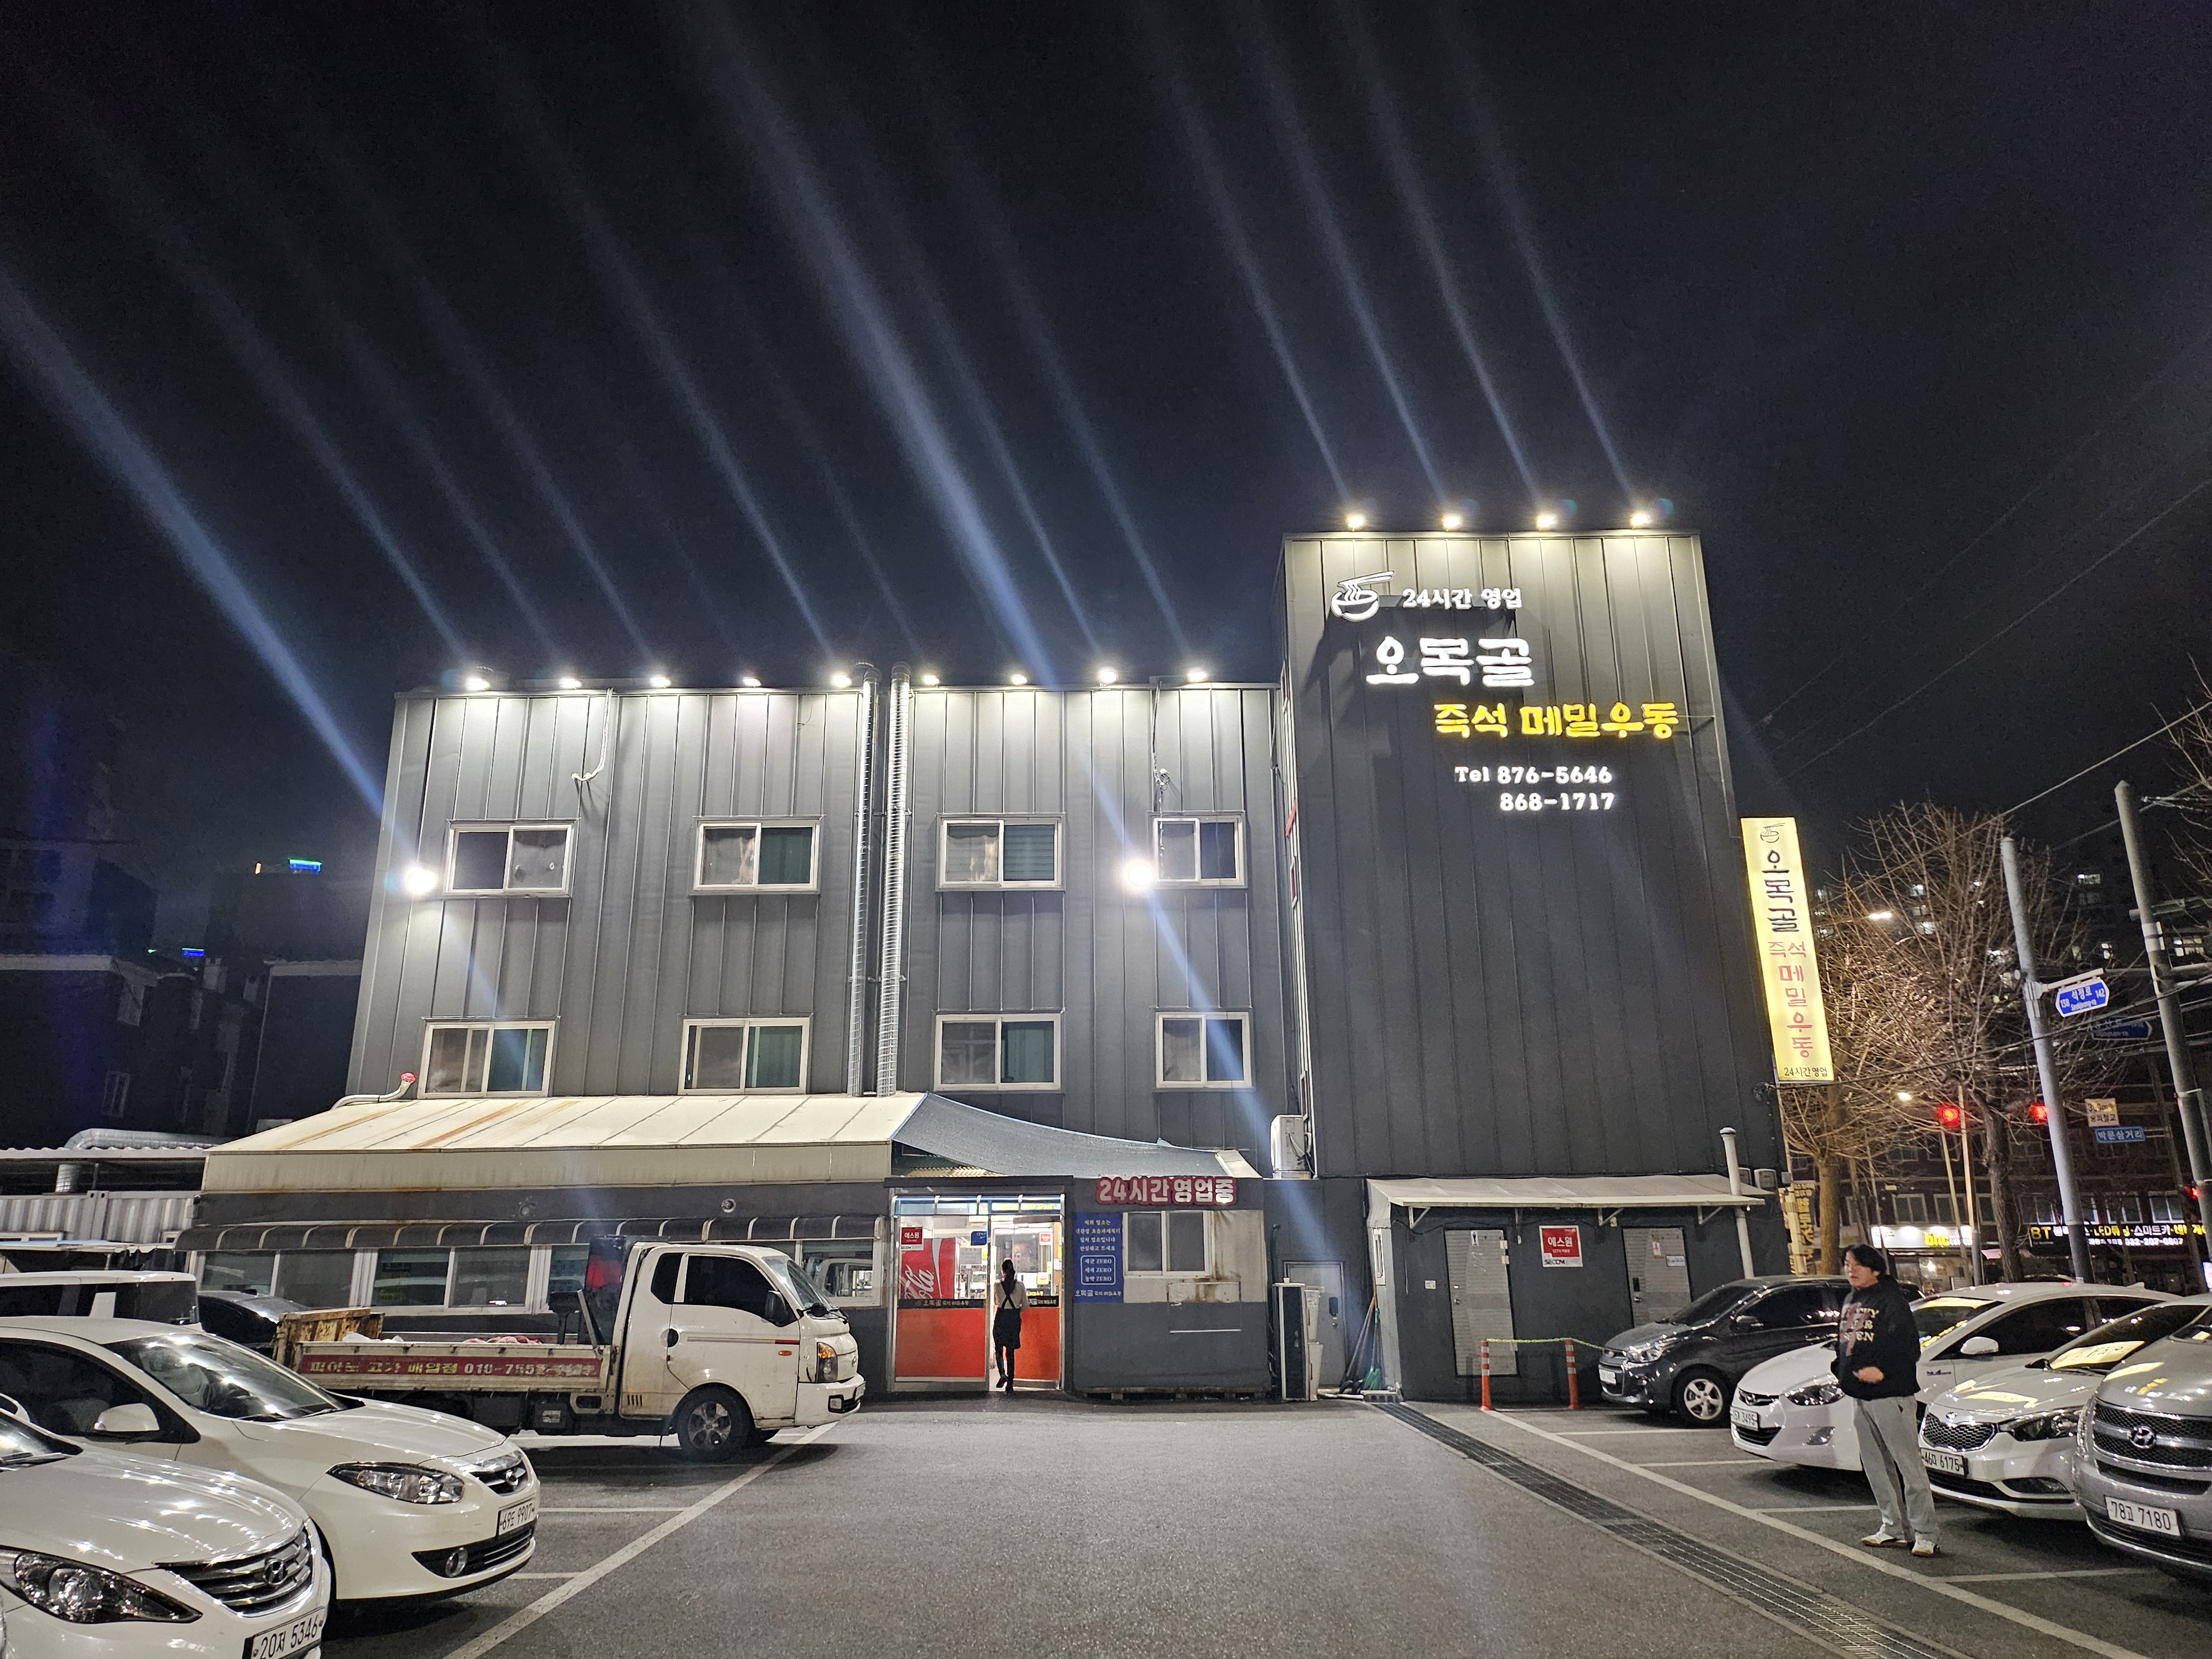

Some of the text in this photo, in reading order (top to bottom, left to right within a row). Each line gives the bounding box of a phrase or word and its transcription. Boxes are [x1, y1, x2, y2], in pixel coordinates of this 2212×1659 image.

[1402, 588, 1522, 609] 24시간 영업
[1366, 636, 1535, 687] 오목골
[1433, 702, 1679, 739] 즉석 메밀우동
[1454, 765, 1613, 784] Tel 876-5646
[1500, 792, 1615, 812] 868-1717
[1761, 849, 1799, 932] 오목골
[1767, 941, 1807, 958] 즉석
[1783, 1067, 1828, 1078] 24시간영업
[2098, 1130, 2142, 1140] 박문삼거리
[1099, 1178, 1234, 1203] 24시간영업중
[1548, 1237, 1573, 1247] 에스원
[1924, 1232, 1949, 1247] bhc
[2030, 1226, 2051, 1240] BT
[310, 1361, 359, 1373] 피아노
[368, 1361, 401, 1373] 고가
[407, 1361, 457, 1374] 매입점
[1940, 1455, 1960, 1472] 6175
[503, 1503, 533, 1530] 69도 9907
[2111, 1501, 2171, 1530] 78고 7180
[291, 1614, 319, 1648] 5346
